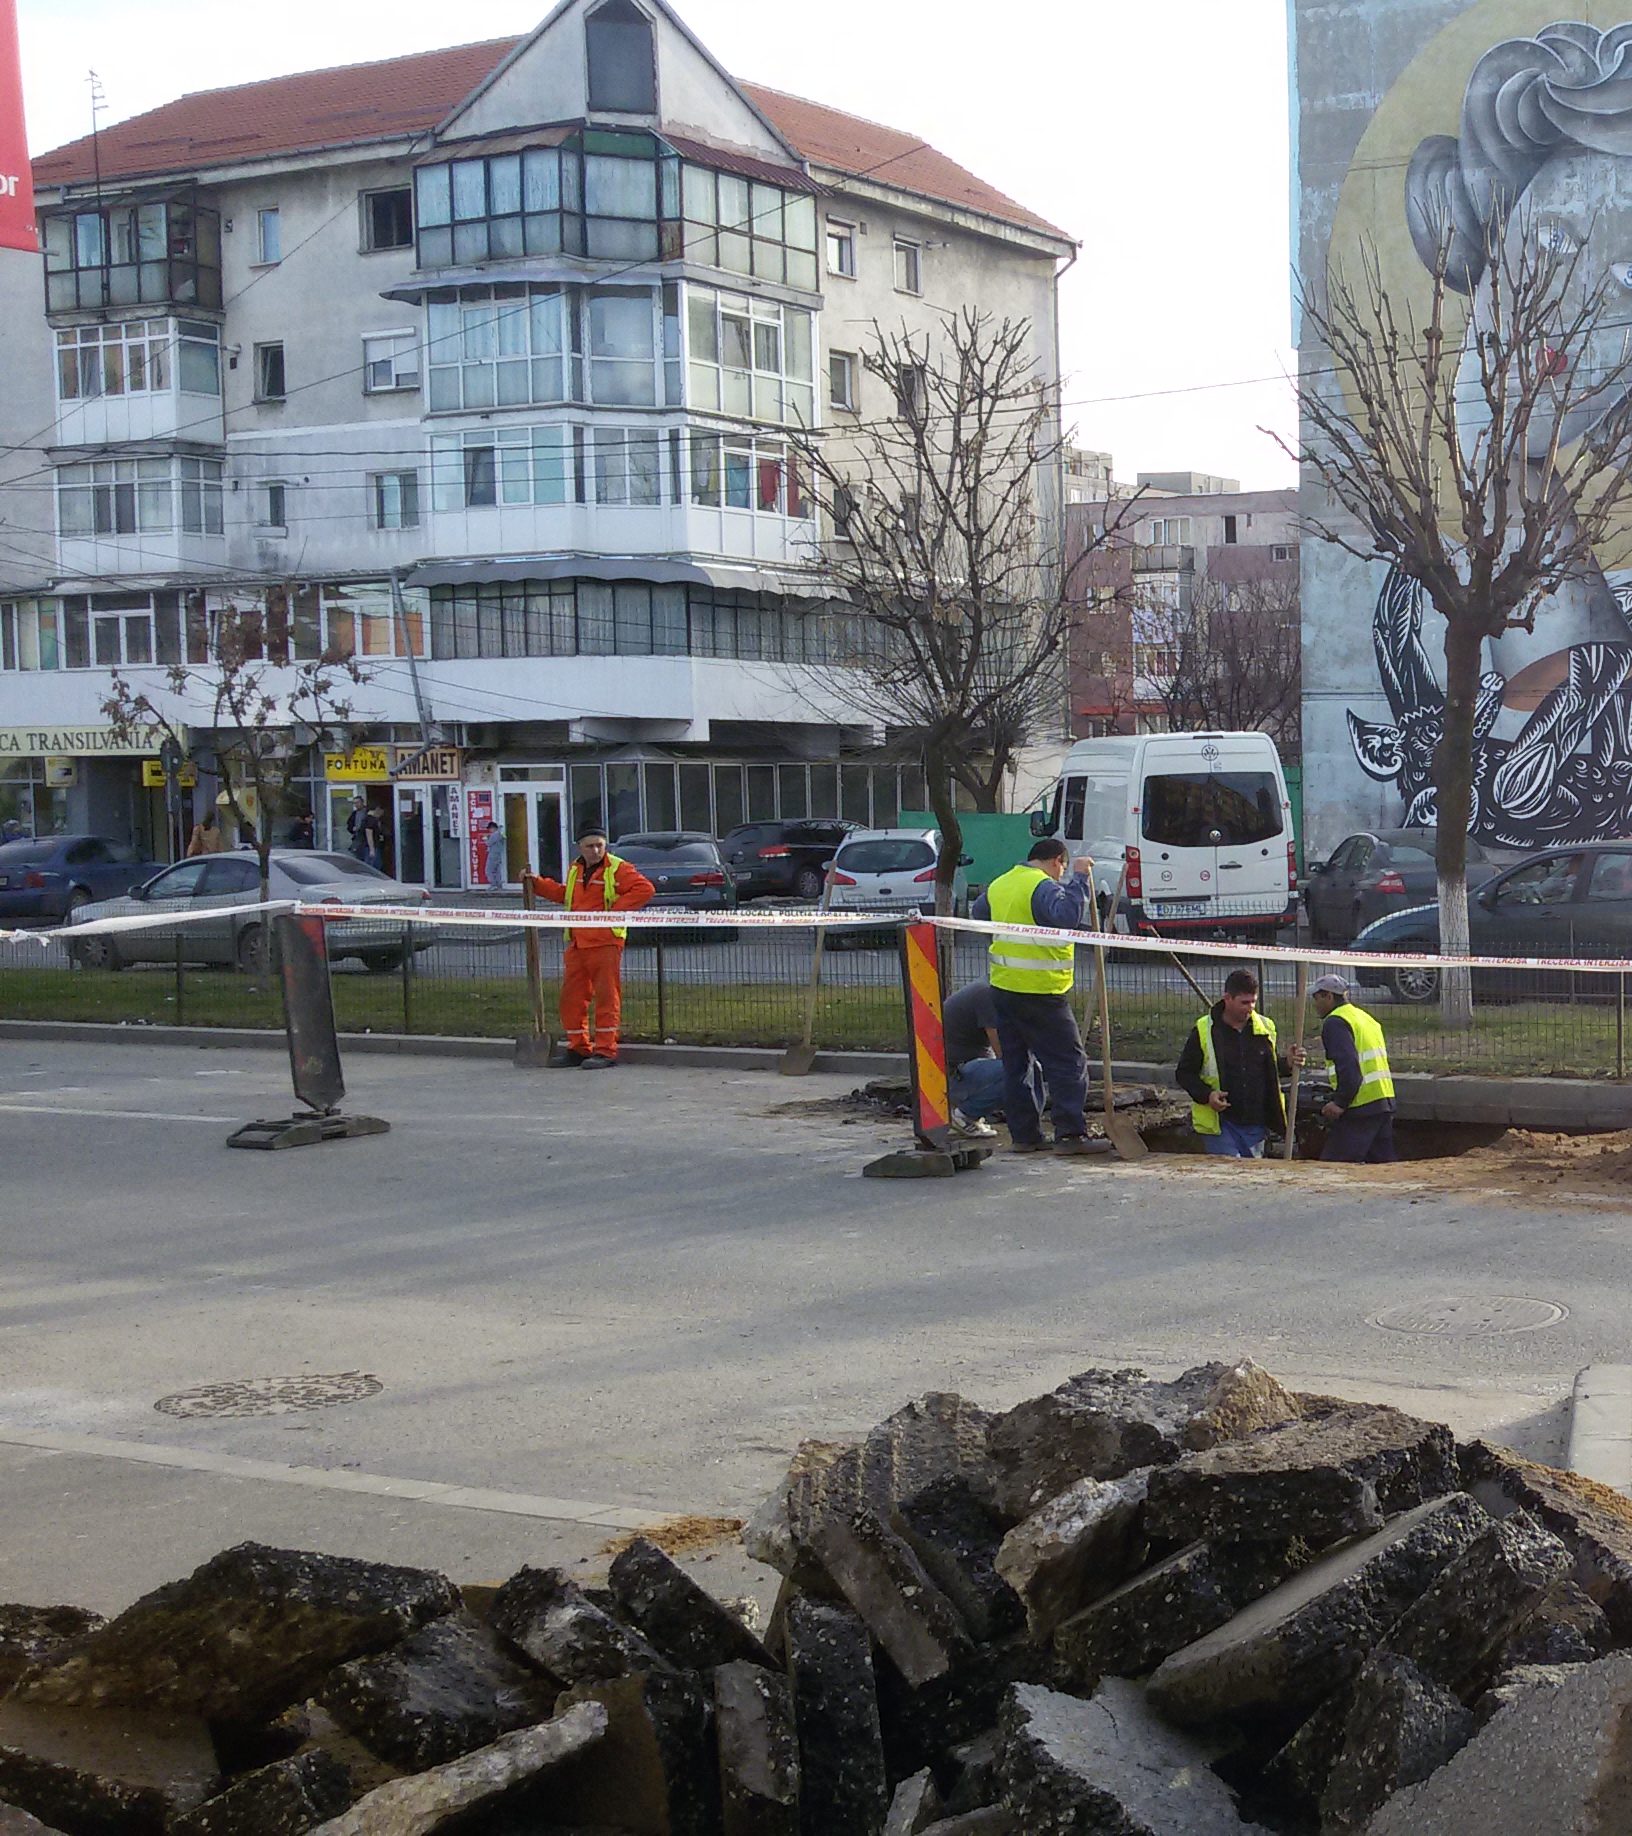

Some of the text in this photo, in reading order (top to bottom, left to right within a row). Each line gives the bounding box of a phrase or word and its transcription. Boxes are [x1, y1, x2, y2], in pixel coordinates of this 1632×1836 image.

[27, 731, 153, 750] TRANSILVANIA
[326, 759, 386, 770] FORTUNA
[400, 753, 456, 775] AMANET
[451, 787, 460, 836] AMANET
